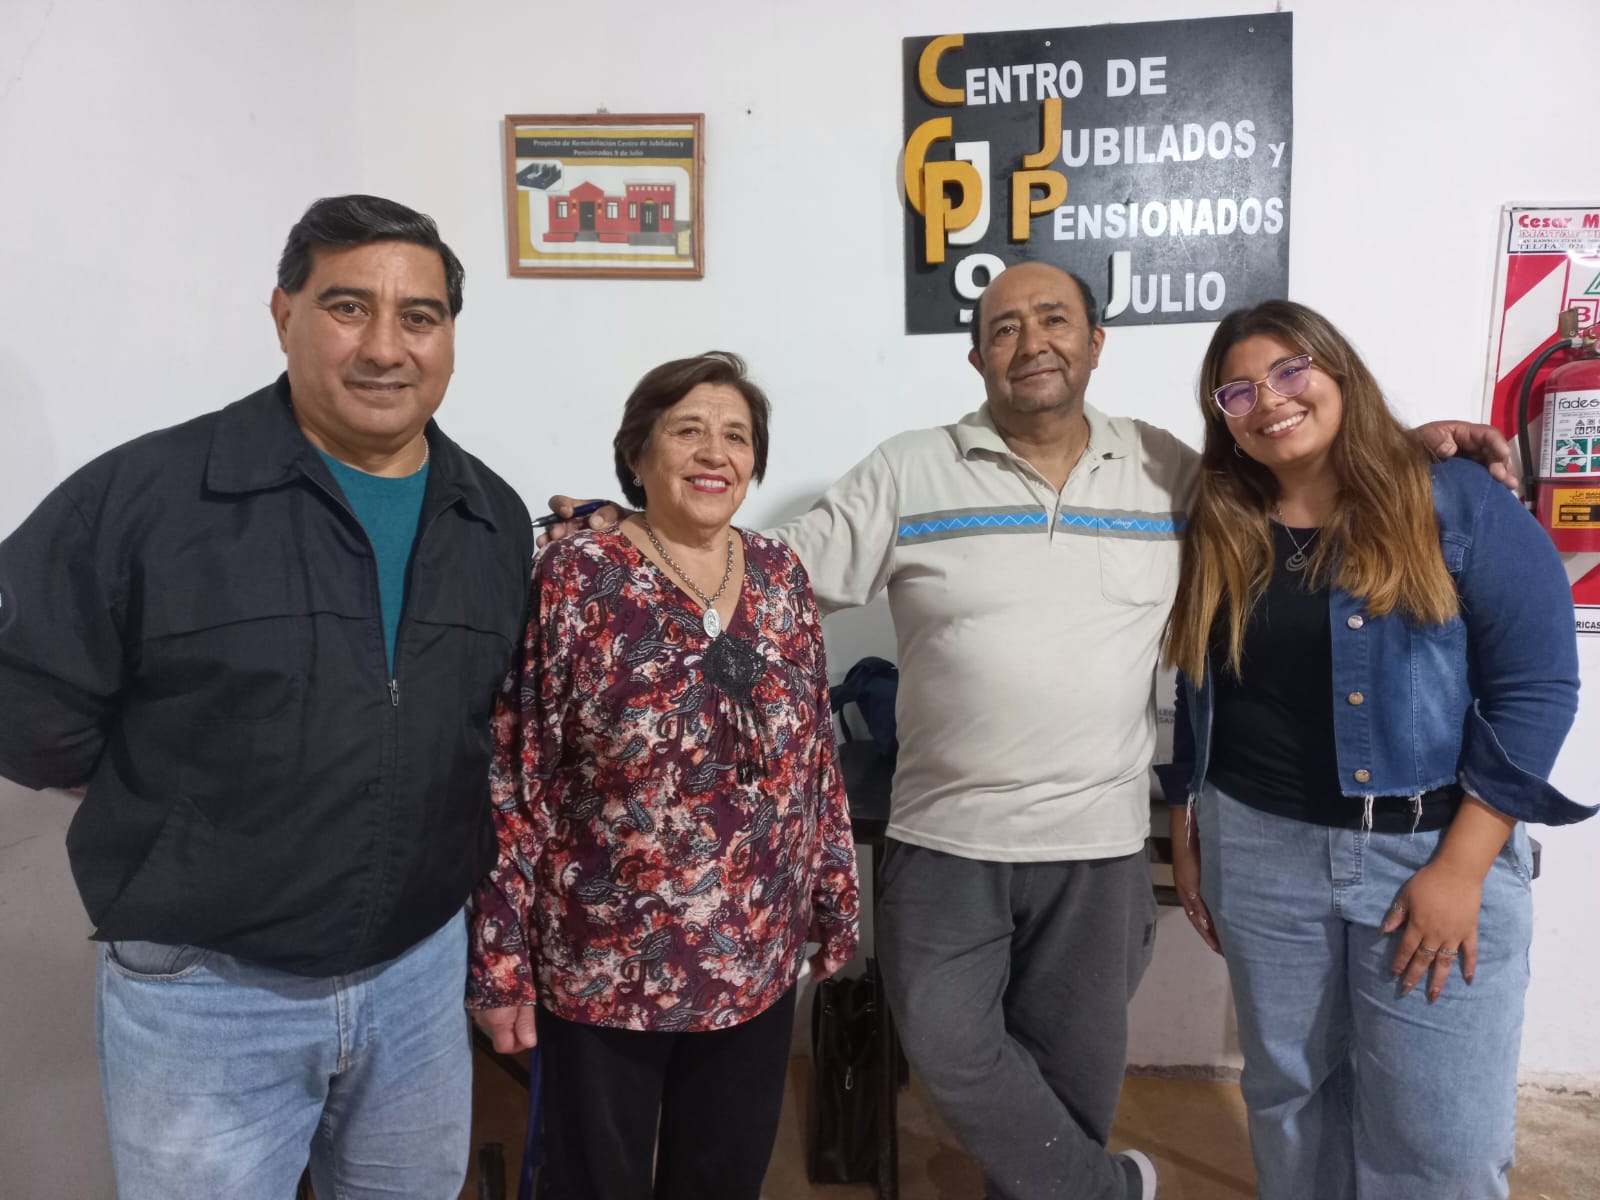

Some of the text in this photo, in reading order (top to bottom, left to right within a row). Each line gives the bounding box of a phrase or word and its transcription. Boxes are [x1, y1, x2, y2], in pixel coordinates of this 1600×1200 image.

[918, 33, 1168, 107] CENTRO DE
[562, 139, 570, 147] de
[640, 139, 648, 147] de
[649, 139, 679, 147] Jubilados
[1022, 97, 1257, 171] JUBILADOS
[1011, 169, 1284, 241] PENSIONADOS
[1518, 214, 1572, 228] Cesar
[1104, 251, 1226, 320] JULIO
